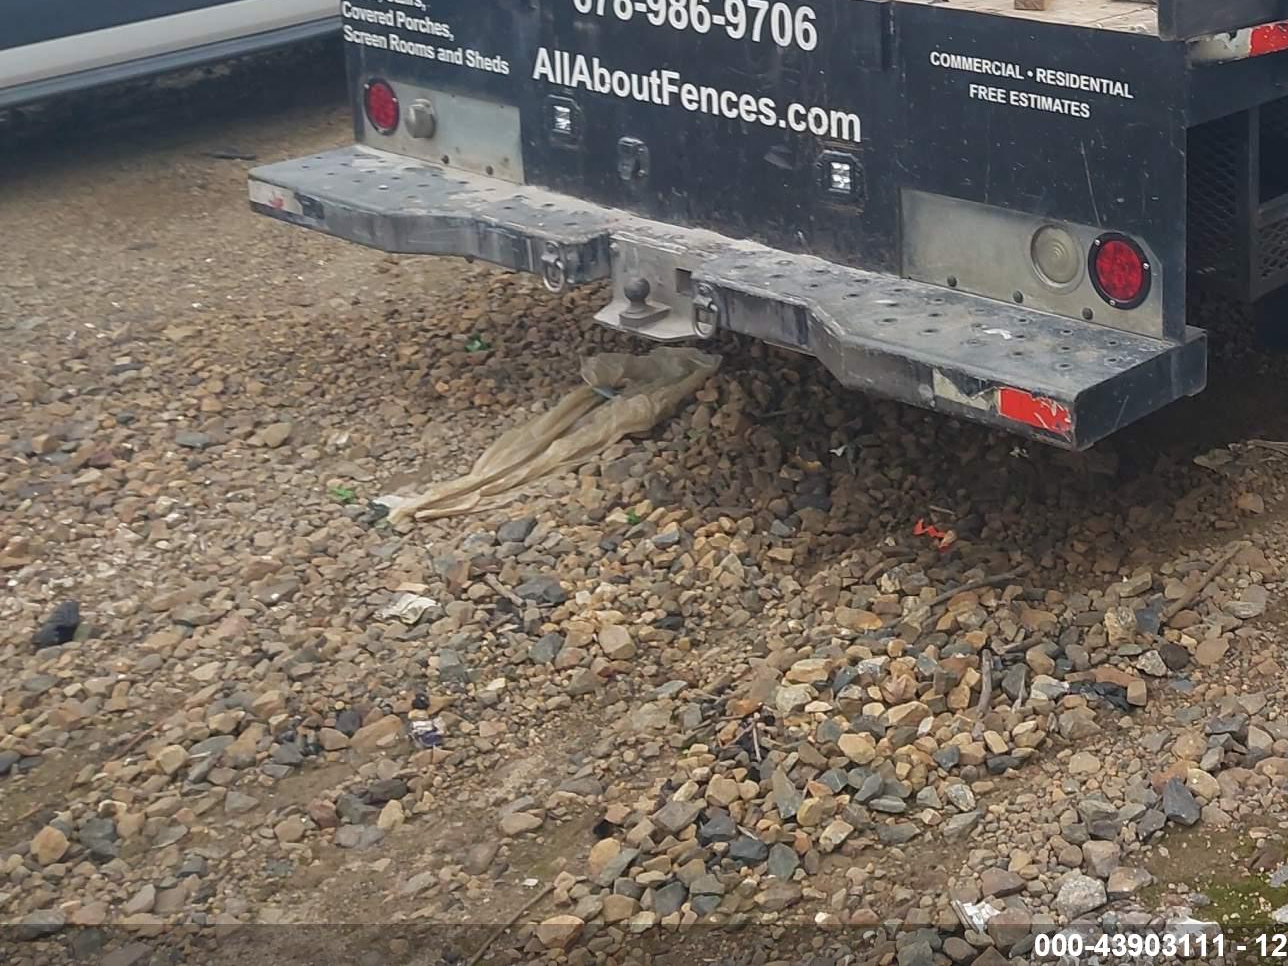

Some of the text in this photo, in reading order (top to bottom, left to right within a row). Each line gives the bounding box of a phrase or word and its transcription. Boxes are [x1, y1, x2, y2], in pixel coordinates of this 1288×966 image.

[341, 1, 454, 41] Covered Porches,
[343, 25, 510, 75] Screen Rooms and Sheds
[532, 47, 861, 142] AllAboutFences.com
[929, 51, 1024, 80] COMMERCIAL
[1036, 67, 1134, 99] RESIDENTIAL
[969, 83, 1091, 119] FREE ESTIMATES
